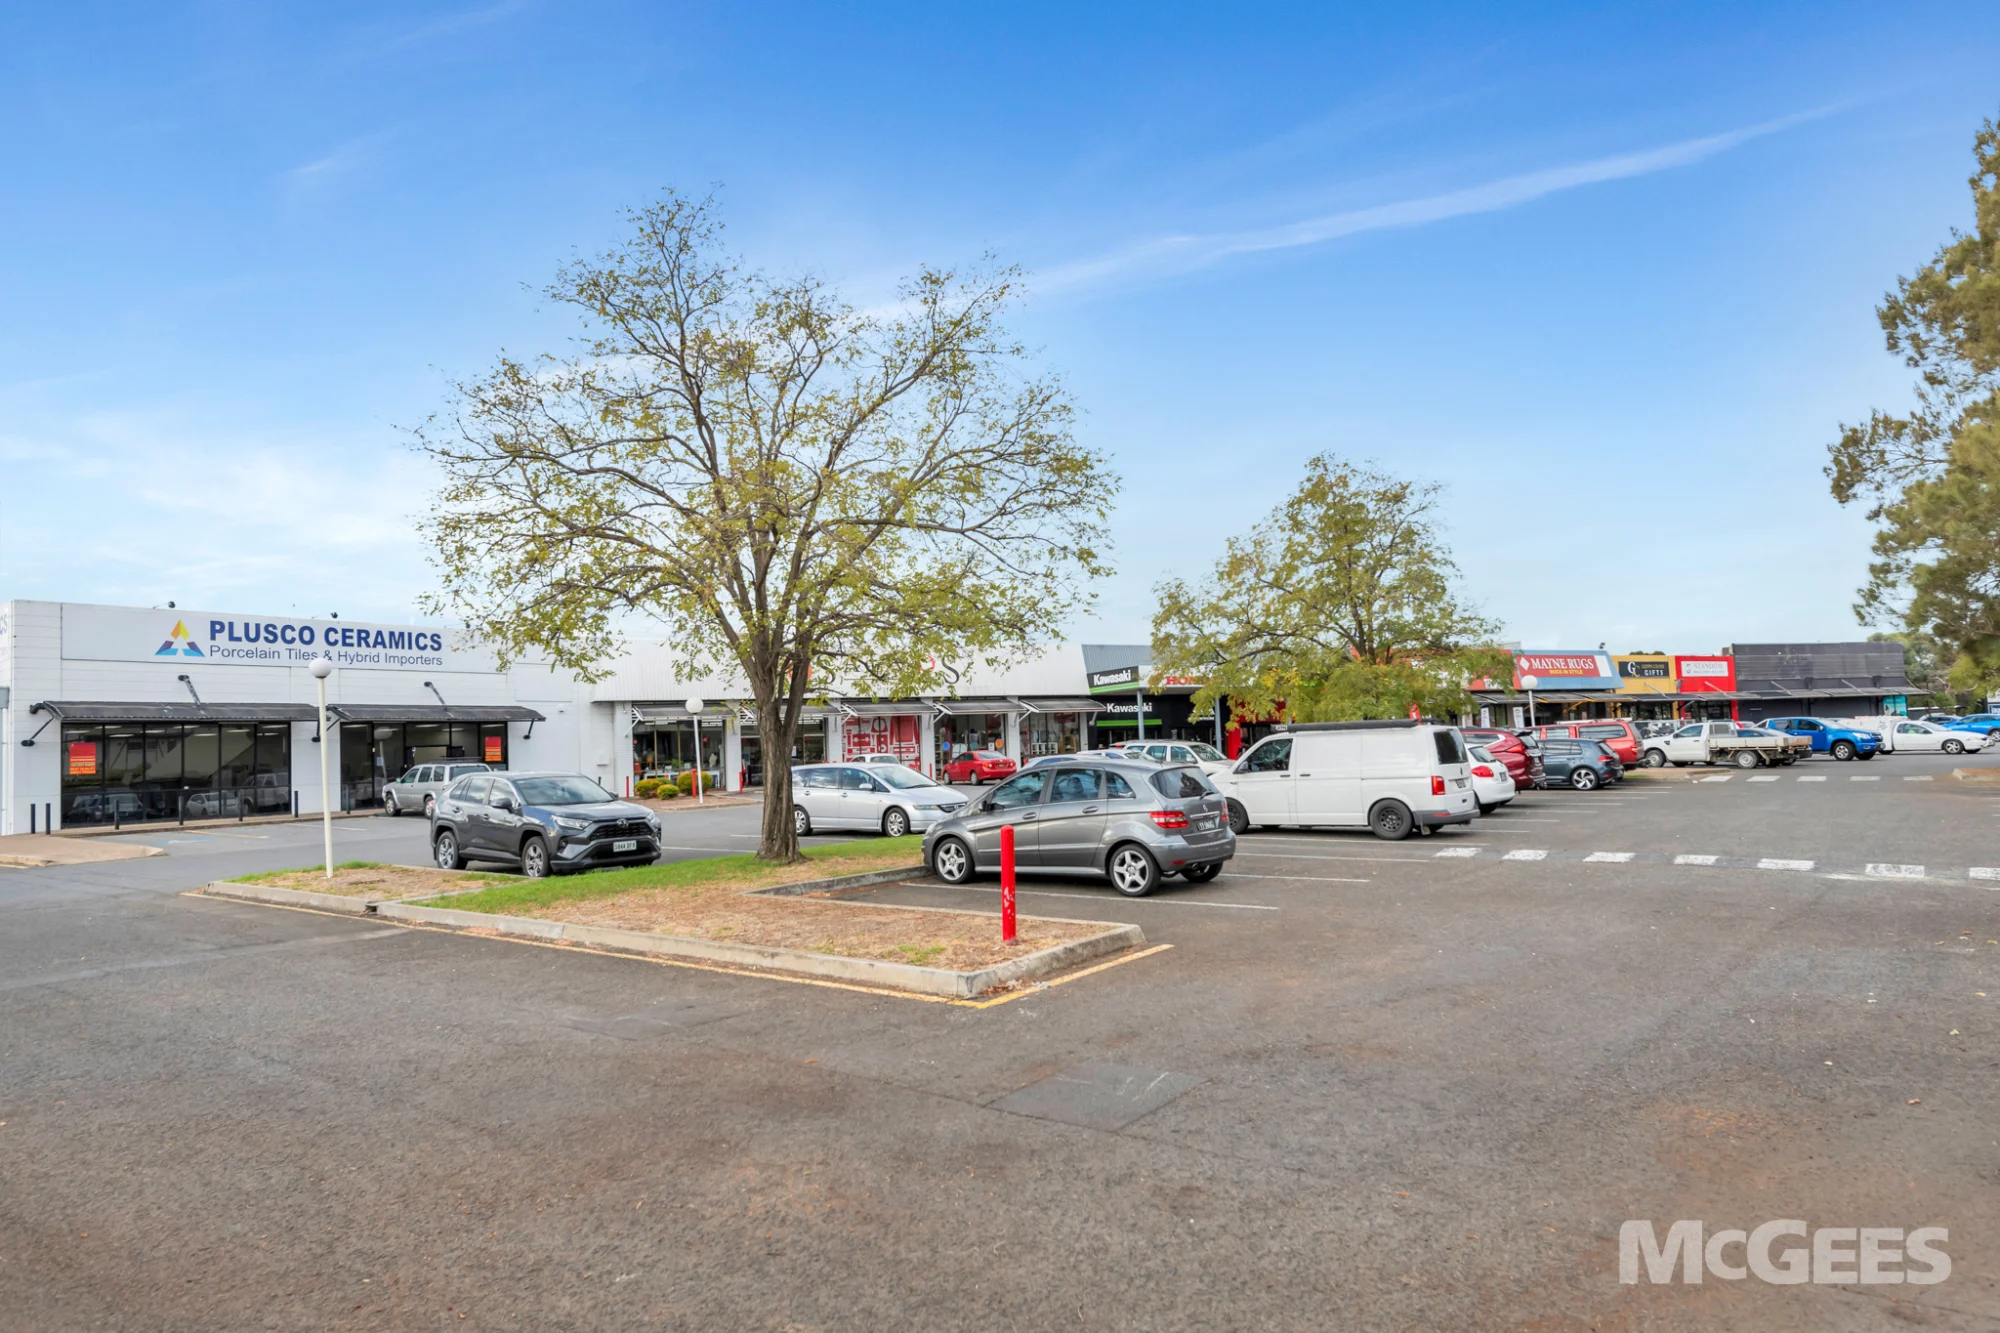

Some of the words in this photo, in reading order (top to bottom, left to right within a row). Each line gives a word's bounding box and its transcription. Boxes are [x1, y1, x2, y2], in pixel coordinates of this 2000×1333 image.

[209, 620, 315, 646] PLUSCO
[324, 627, 443, 651] CERAMICS
[210, 645, 281, 660] Porcelain
[285, 648, 318, 661] Tiles
[323, 650, 333, 661] &
[338, 650, 380, 665] Hybrid
[384, 651, 443, 666] Importers
[1530, 657, 1567, 669] MAYNE
[1567, 658, 1594, 669] RUGS
[1093, 669, 1131, 686] Kawasaki
[1106, 702, 1152, 713] Kawaski
